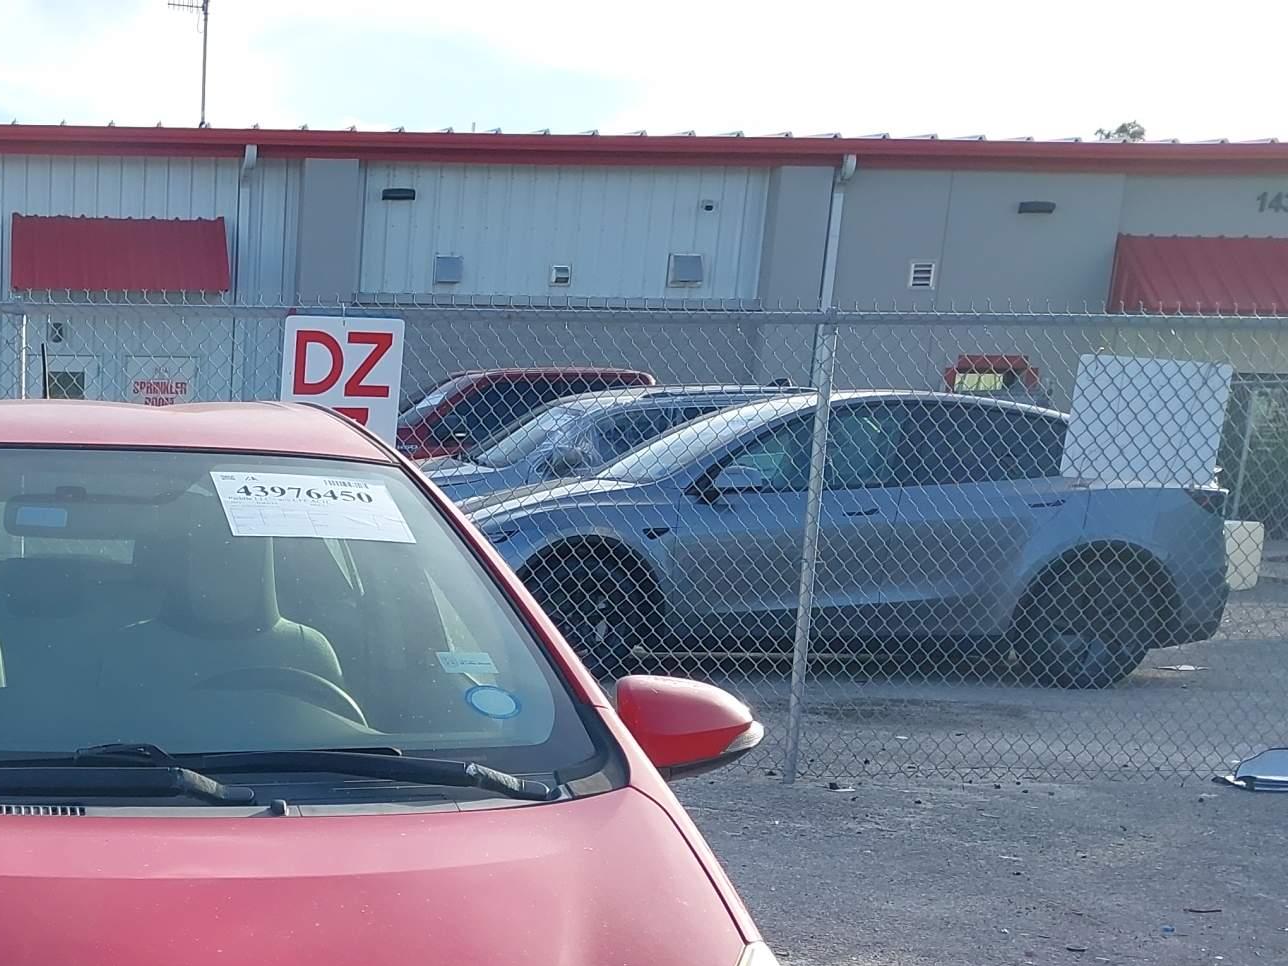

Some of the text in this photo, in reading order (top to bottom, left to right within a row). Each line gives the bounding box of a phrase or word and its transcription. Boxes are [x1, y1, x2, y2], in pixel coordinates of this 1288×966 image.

[293, 329, 393, 398] DZ
[132, 380, 187, 395] SPRINKLER
[236, 484, 374, 504] 43976450
